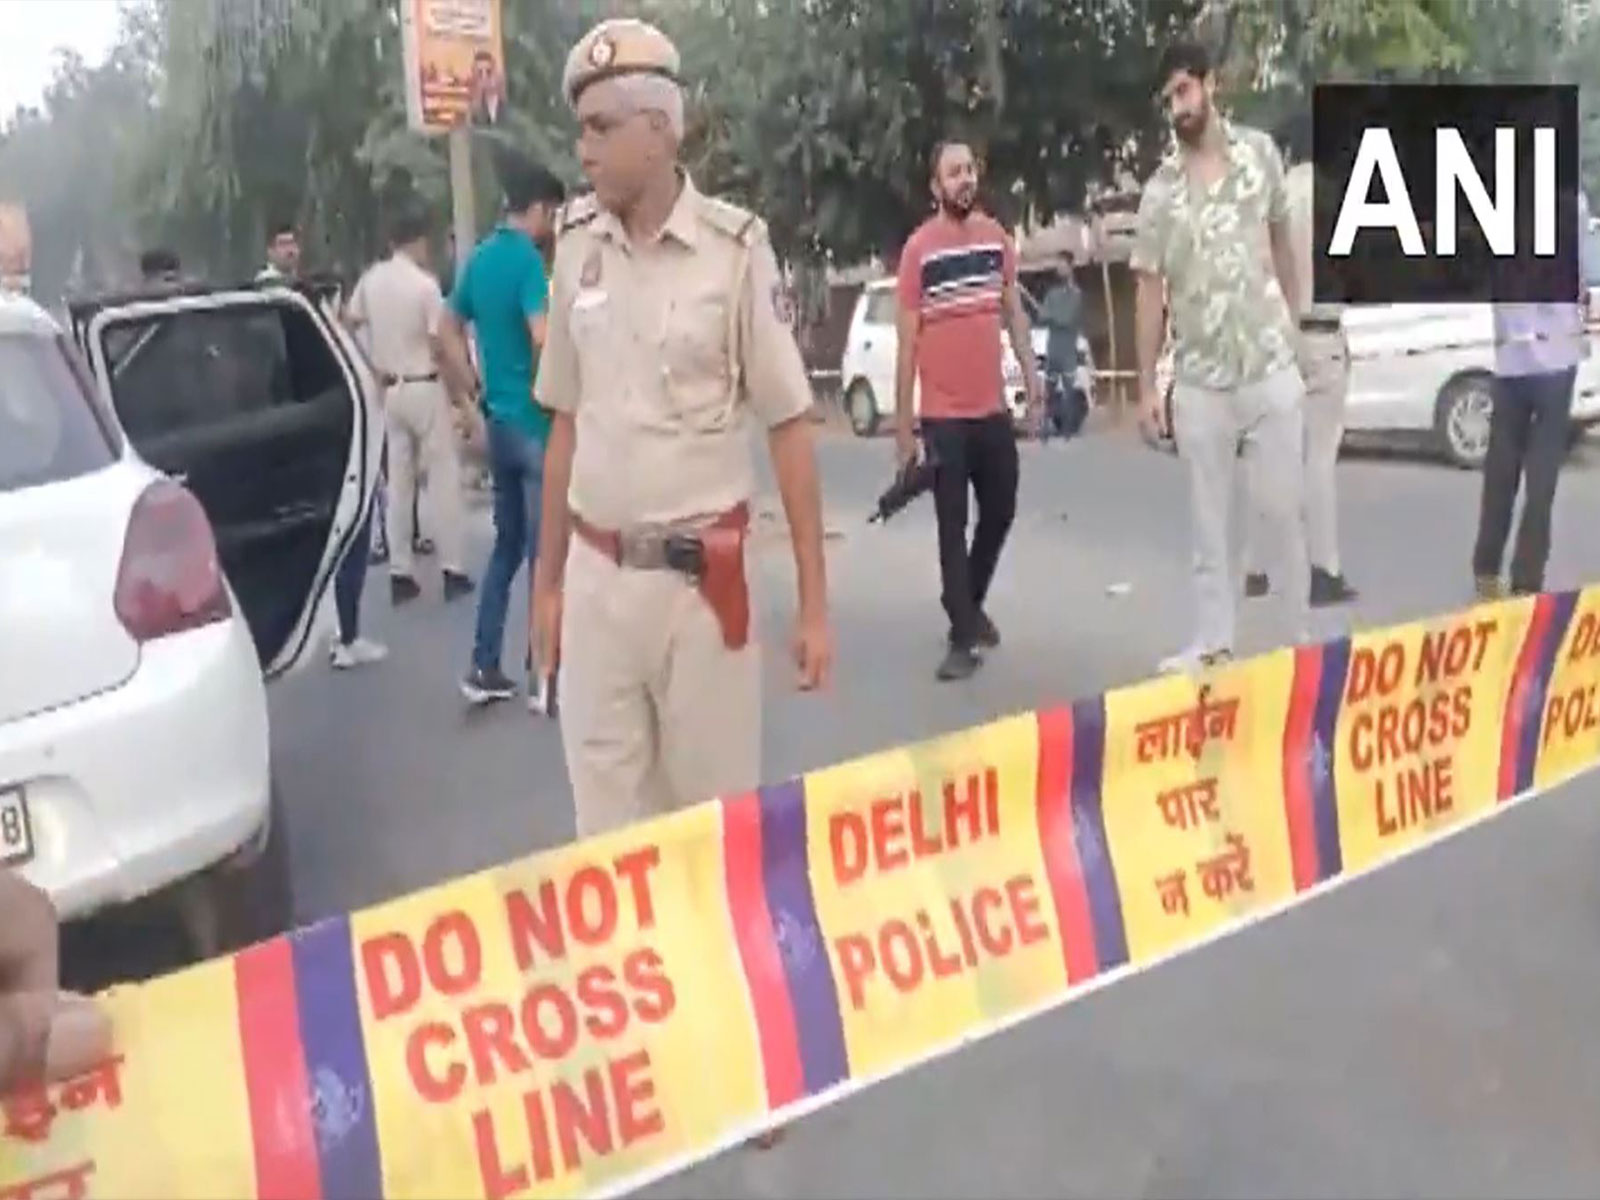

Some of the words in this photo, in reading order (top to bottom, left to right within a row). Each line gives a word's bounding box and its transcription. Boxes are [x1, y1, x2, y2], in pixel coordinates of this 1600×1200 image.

[1347, 643, 1404, 703] DO
[1415, 624, 1498, 678] NOT
[1136, 685, 1239, 763] लाईन
[1350, 686, 1471, 772] CROSS
[829, 766, 1000, 884] DELHI
[1156, 777, 1220, 830] पार
[1377, 764, 1453, 836] LINE
[361, 912, 483, 1021] DO
[506, 845, 661, 972] NOT
[834, 878, 1050, 1010] POLICE
[405, 946, 677, 1104] CROSS
[473, 1051, 665, 1199] LINE
